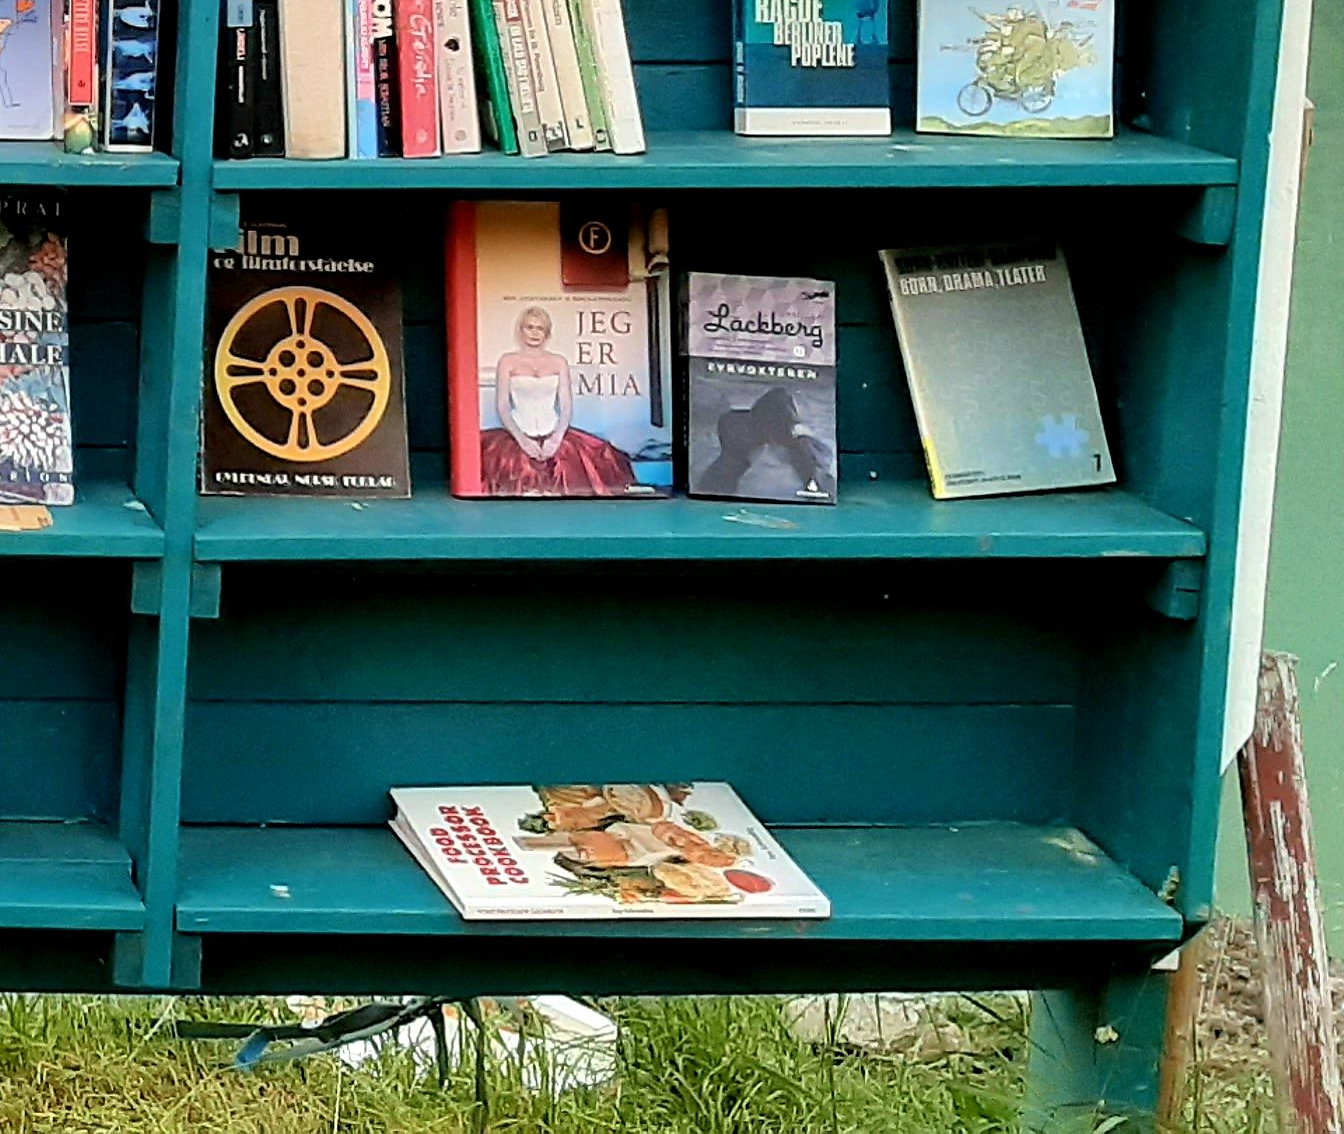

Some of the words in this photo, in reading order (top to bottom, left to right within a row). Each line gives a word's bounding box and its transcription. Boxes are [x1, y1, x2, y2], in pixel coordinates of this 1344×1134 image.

[791, 43, 855, 68] POPLENE
[213, 257, 235, 270] og
[576, 310, 633, 336] JEG
[576, 342, 618, 365] ER
[576, 373, 641, 396] MIA
[429, 827, 468, 864] FOOD
[438, 805, 508, 886] PROCESSOR
[461, 806, 530, 884] COOKBOOK
